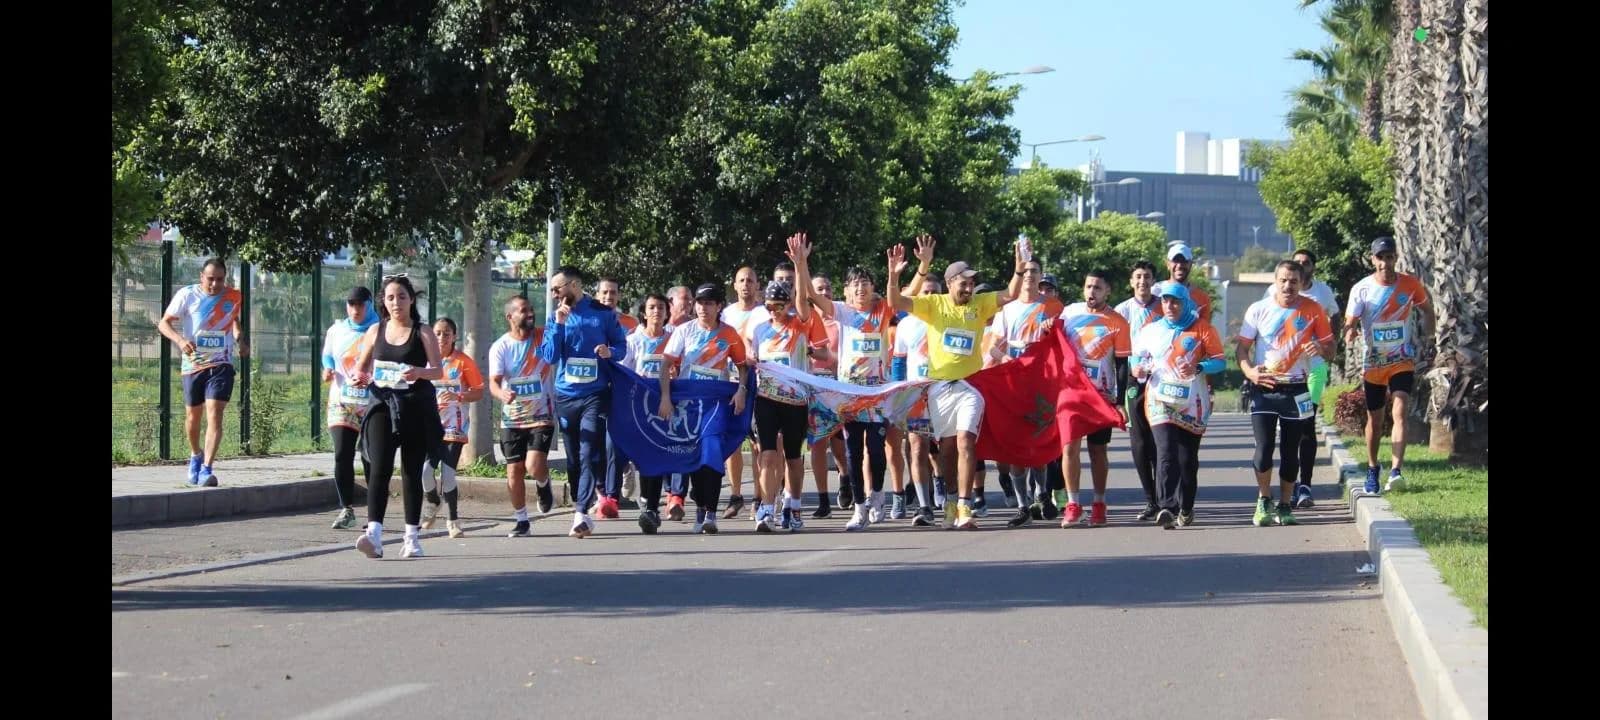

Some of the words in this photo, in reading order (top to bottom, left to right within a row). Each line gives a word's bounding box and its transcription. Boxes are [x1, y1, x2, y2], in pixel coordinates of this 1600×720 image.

[1379, 329, 1399, 341] 705
[201, 337, 220, 347] 700
[857, 341, 875, 350] 704
[949, 335, 968, 348] 707
[571, 366, 591, 377] 712
[346, 386, 366, 398] 689
[516, 384, 535, 395] 711
[1163, 383, 1184, 396] 686
